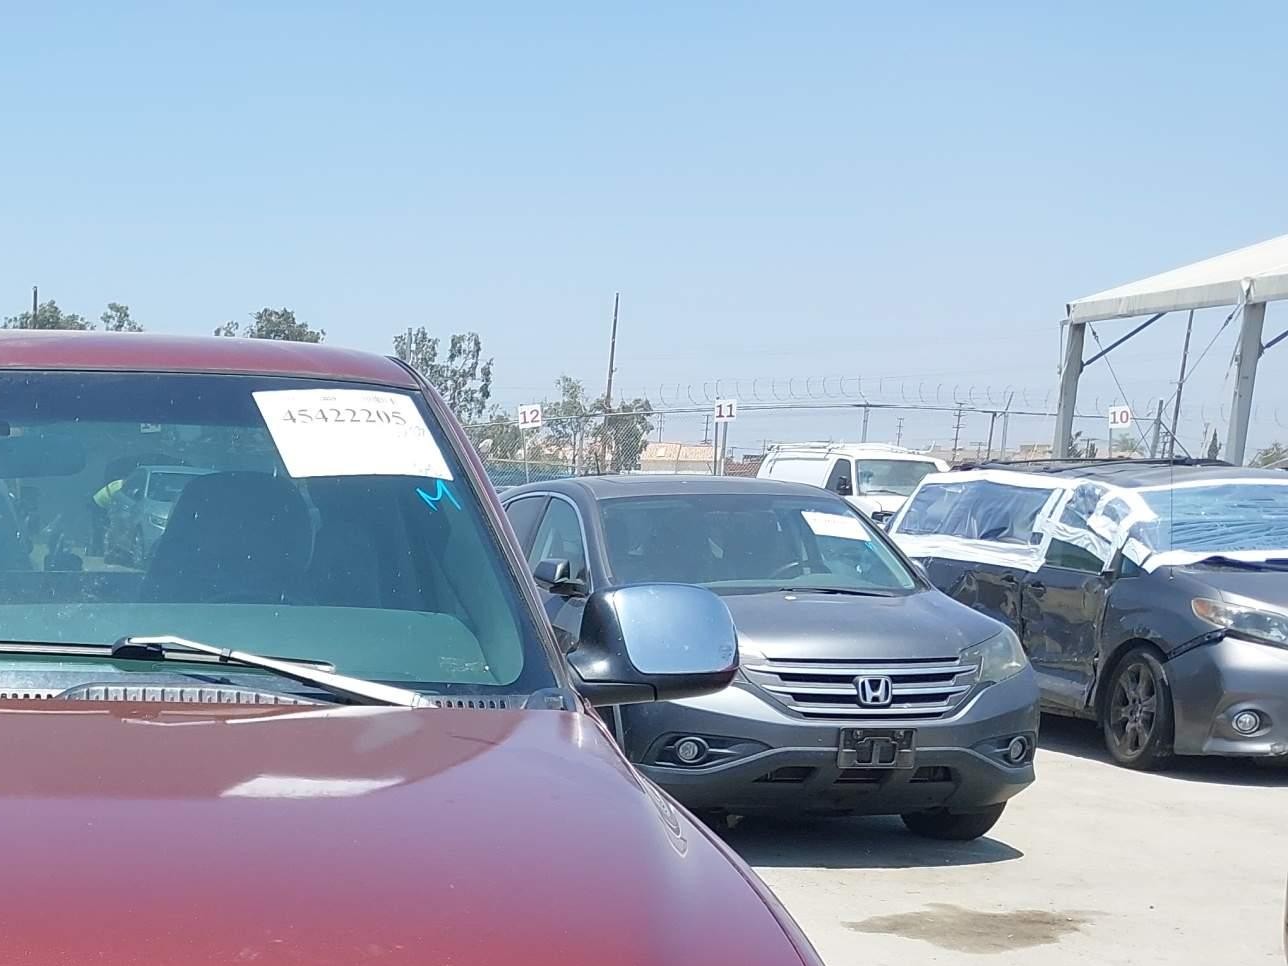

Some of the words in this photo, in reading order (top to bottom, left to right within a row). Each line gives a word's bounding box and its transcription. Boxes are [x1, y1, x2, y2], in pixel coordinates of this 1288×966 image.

[280, 408, 407, 425] 45422205
[520, 409, 540, 425] 12
[715, 404, 736, 419] 11
[1110, 410, 1129, 425] 10
